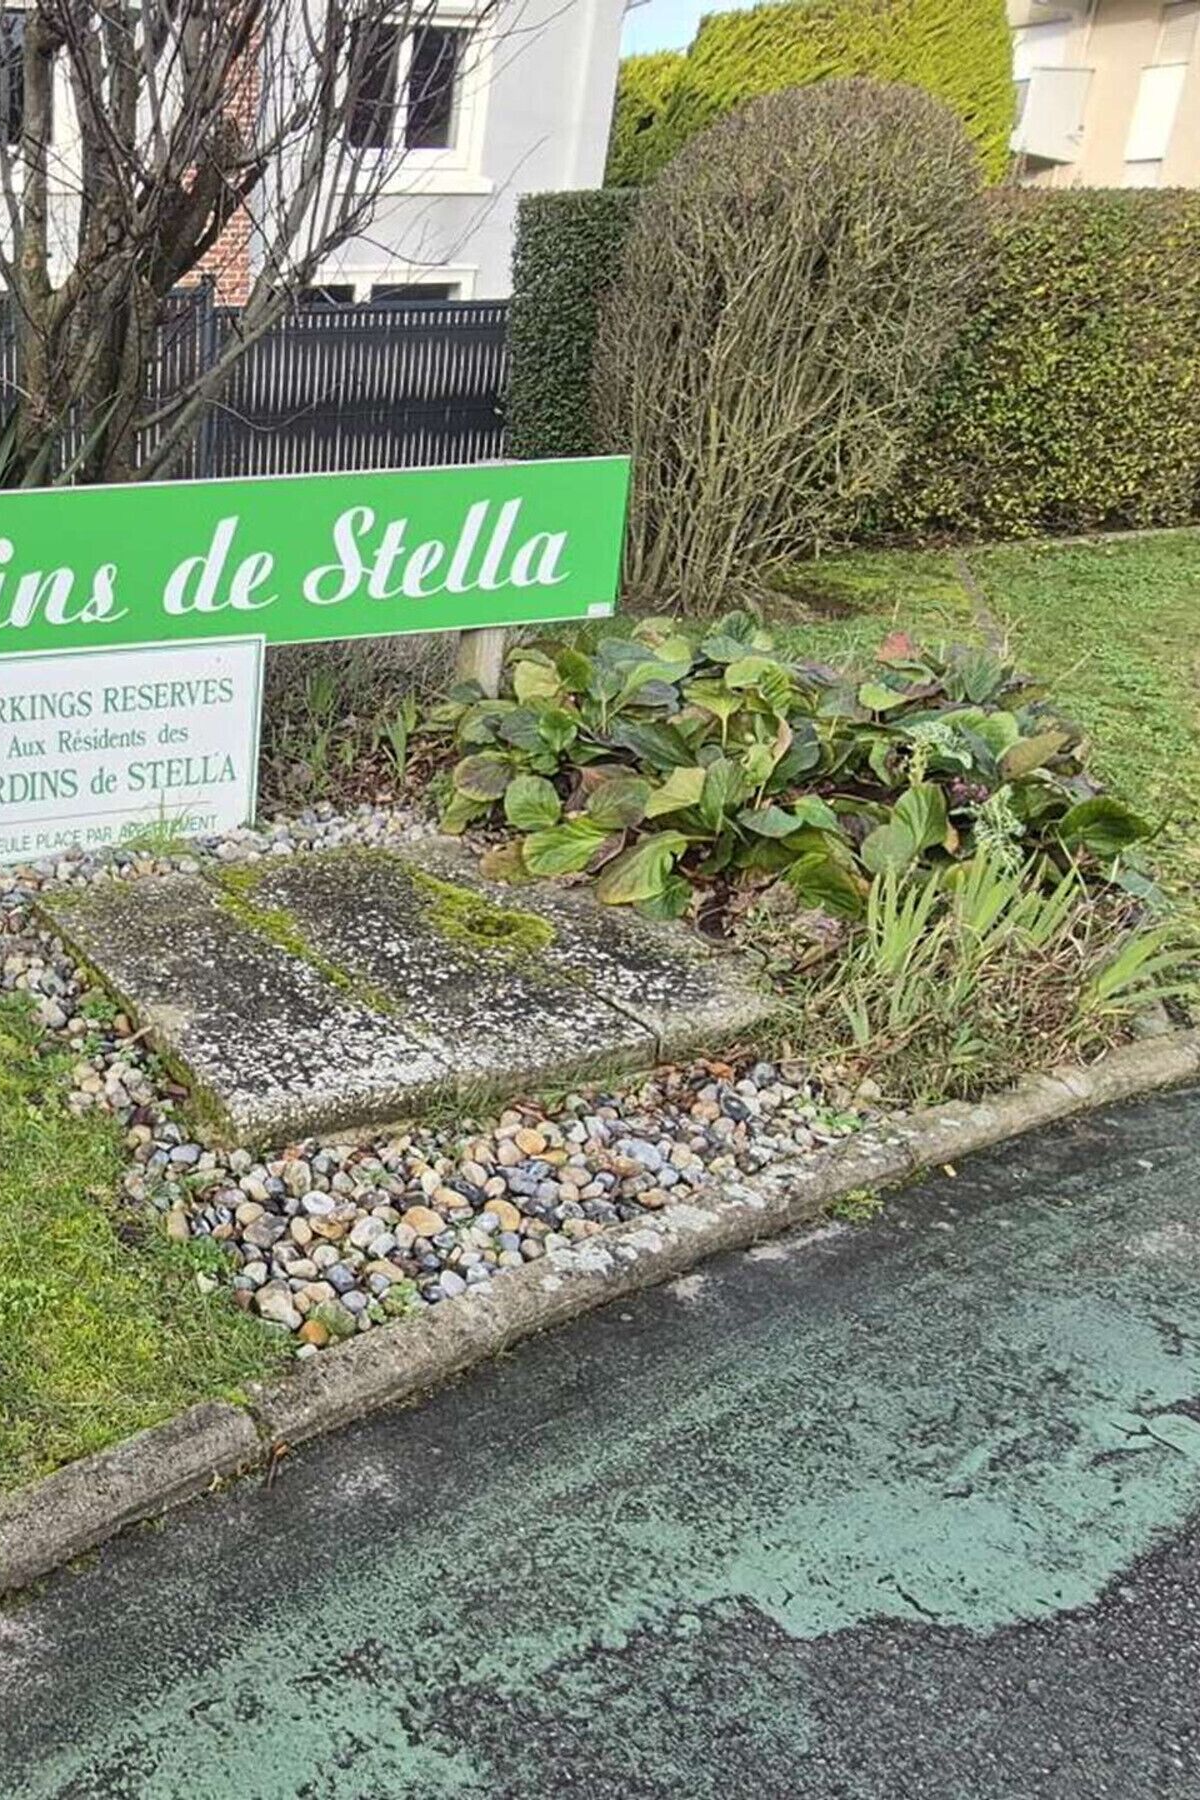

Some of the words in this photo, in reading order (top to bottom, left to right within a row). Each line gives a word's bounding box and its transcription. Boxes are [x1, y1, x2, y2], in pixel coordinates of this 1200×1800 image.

[162, 515, 279, 615] de
[302, 496, 570, 605] Stella
[103, 677, 234, 714] RESERVES
[7, 735, 46, 759] Aux
[58, 727, 146, 754] Résidents
[159, 723, 189, 744] des
[90, 768, 118, 795] de
[127, 754, 237, 792] STELLA
[36, 830, 80, 849] PLACE
[86, 826, 113, 843] PAR
